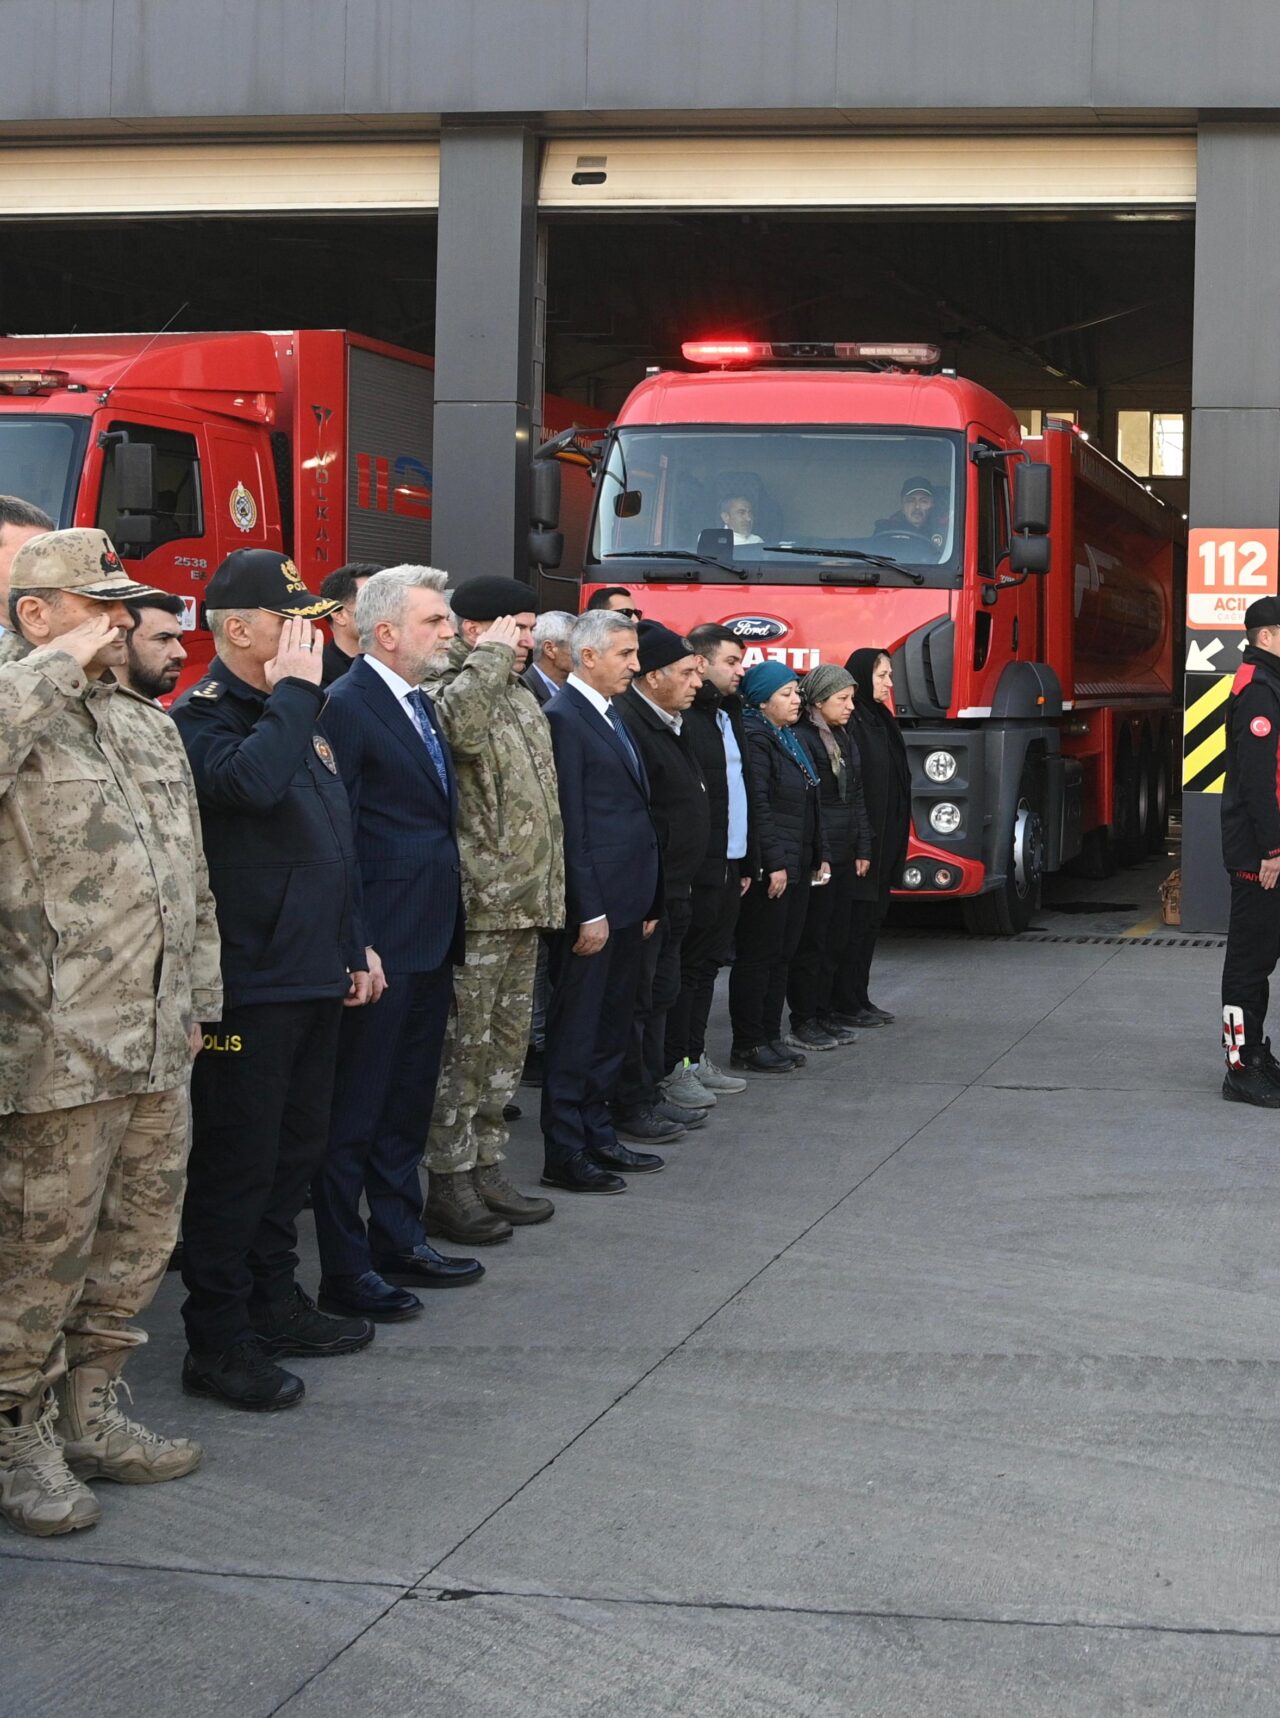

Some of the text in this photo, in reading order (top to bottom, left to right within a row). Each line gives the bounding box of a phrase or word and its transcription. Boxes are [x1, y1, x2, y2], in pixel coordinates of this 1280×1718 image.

[356, 453, 432, 521] 112
[174, 556, 208, 569] 2538
[1199, 541, 1267, 586] 112
[733, 620, 771, 636] Ford
[202, 1033, 242, 1052] OLİS
